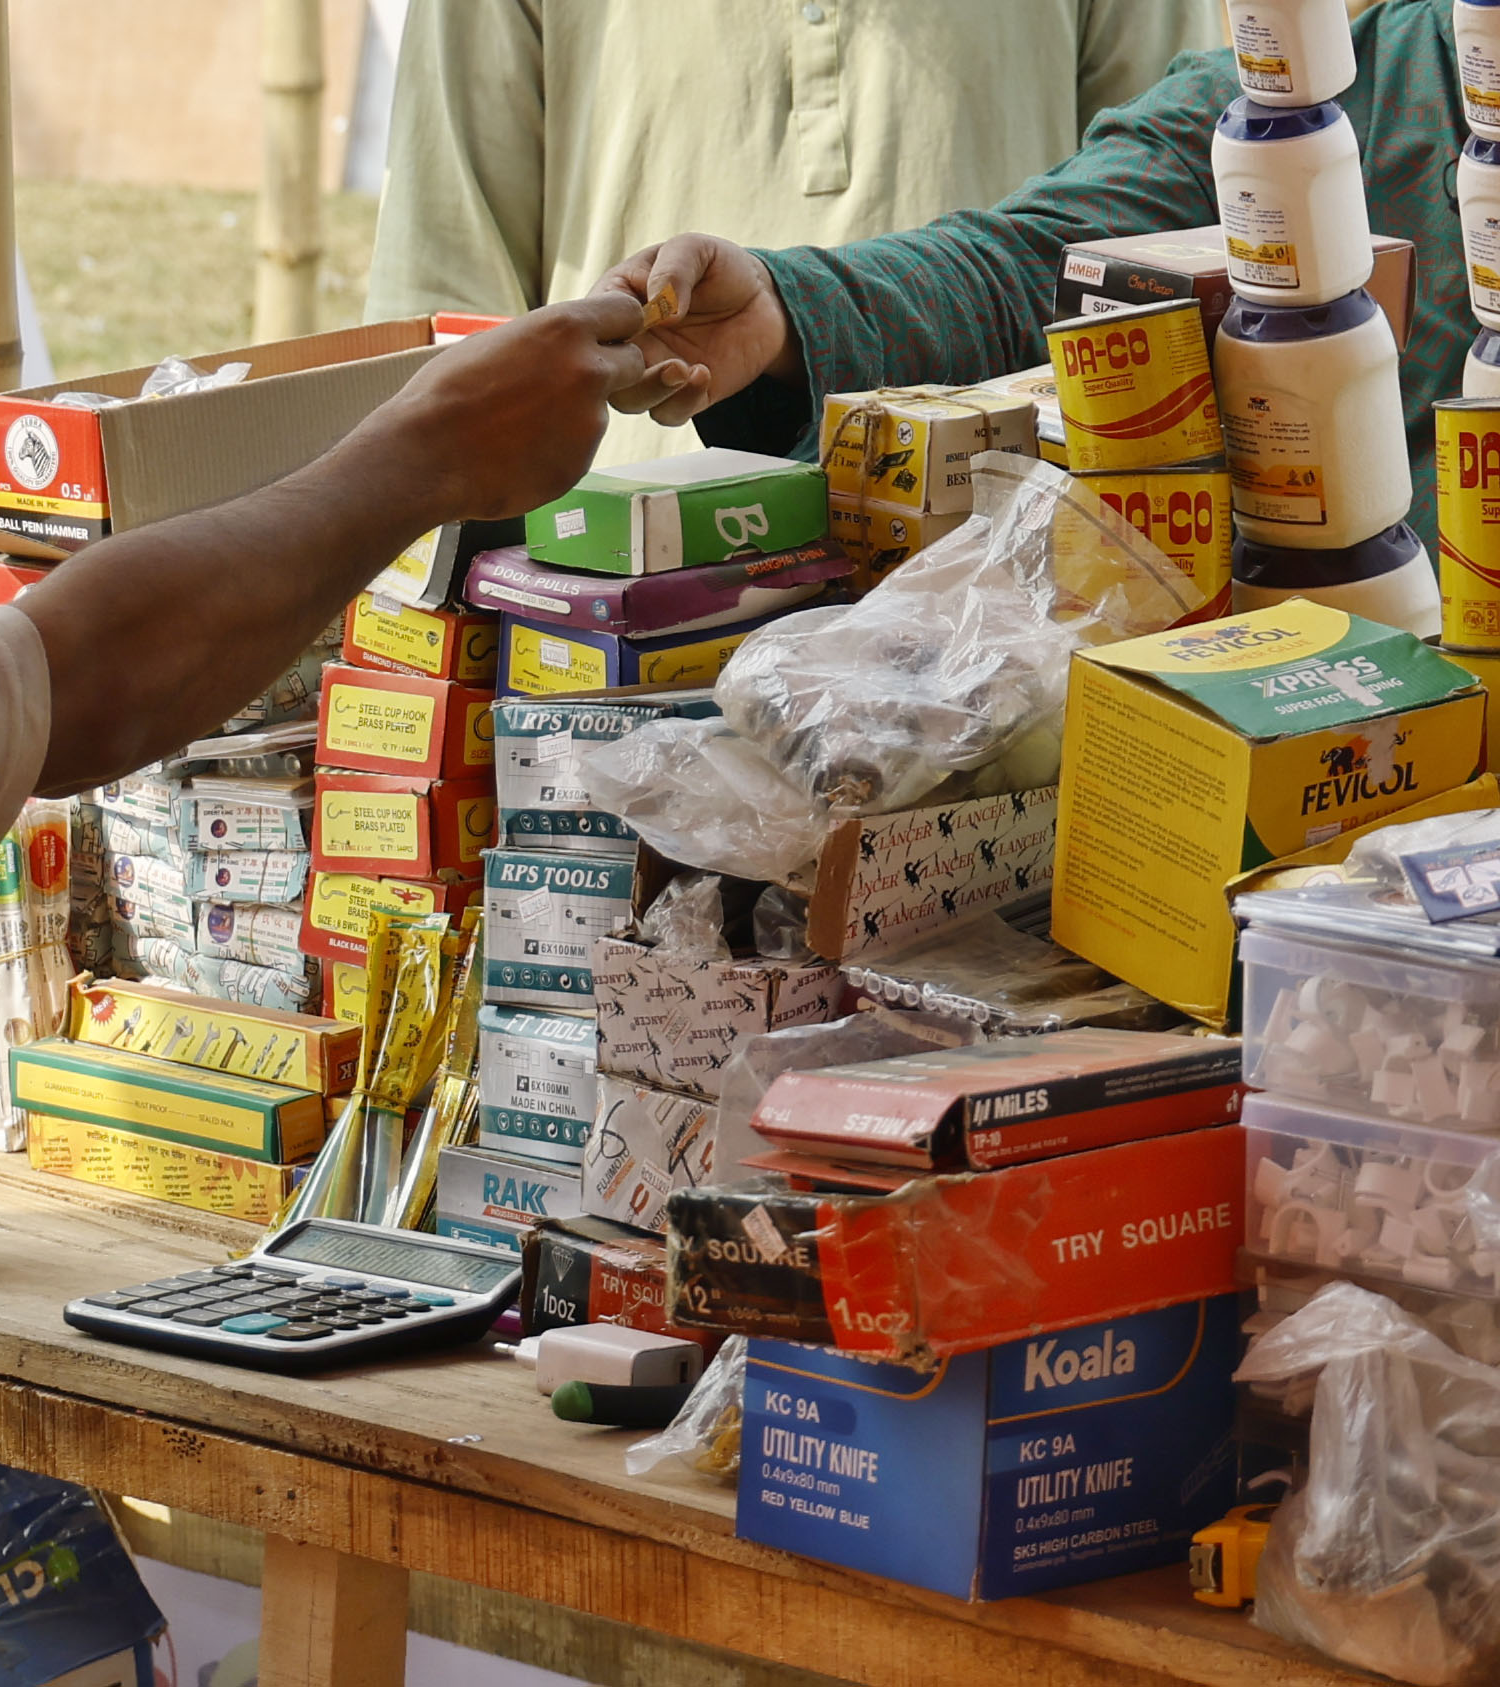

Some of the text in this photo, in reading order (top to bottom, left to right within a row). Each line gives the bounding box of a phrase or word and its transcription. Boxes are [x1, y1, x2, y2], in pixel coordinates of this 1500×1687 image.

[1062, 327, 1151, 377] DA-CO
[1083, 376, 1135, 393] Super Quality
[22, 520, 43, 535] PEIN
[45, 522, 89, 541] HAMMER
[745, 548, 827, 576] SHANGHAI CHINA
[492, 564, 581, 596] DOOR PULLS
[1170, 627, 1301, 662] FEVICOL
[359, 703, 427, 723] STEEL CUP HOOK
[522, 711, 634, 734] RPS TOOLS
[1301, 761, 1420, 816] FEVICOL
[353, 807, 412, 821] STEEL CUP HOOK
[354, 821, 405, 834] BRASS PLATED
[957, 801, 1008, 829] LANCER
[879, 823, 933, 851] LANCER
[500, 864, 610, 891] RPS TOOLS
[883, 902, 937, 929] LANCER
[507, 1013, 594, 1043] FT TOOLS
[529, 1079, 570, 1096] 6X100MM
[510, 1095, 578, 1118] MADE IN CHINA
[973, 1131, 1002, 1149] TP-10
[596, 1146, 631, 1196] FUJIMOTO
[1053, 1203, 1232, 1264] TRY SQUARE
[1025, 1328, 1136, 1392] Koala
[765, 1389, 821, 1424] KC 9A
[762, 1425, 879, 1484] UTILITY KNIFE
[1019, 1433, 1076, 1463] KC 9A
[761, 1463, 841, 1498] 0.4x9x80 mm
[1017, 1457, 1133, 1510] UTILITY KNIFE
[760, 1489, 870, 1530] RED YELLOW BLUE
[1015, 1503, 1096, 1534] 0.4x9x80 mm
[1013, 1518, 1159, 1561] SK5 HIGH CARBON STEEL
